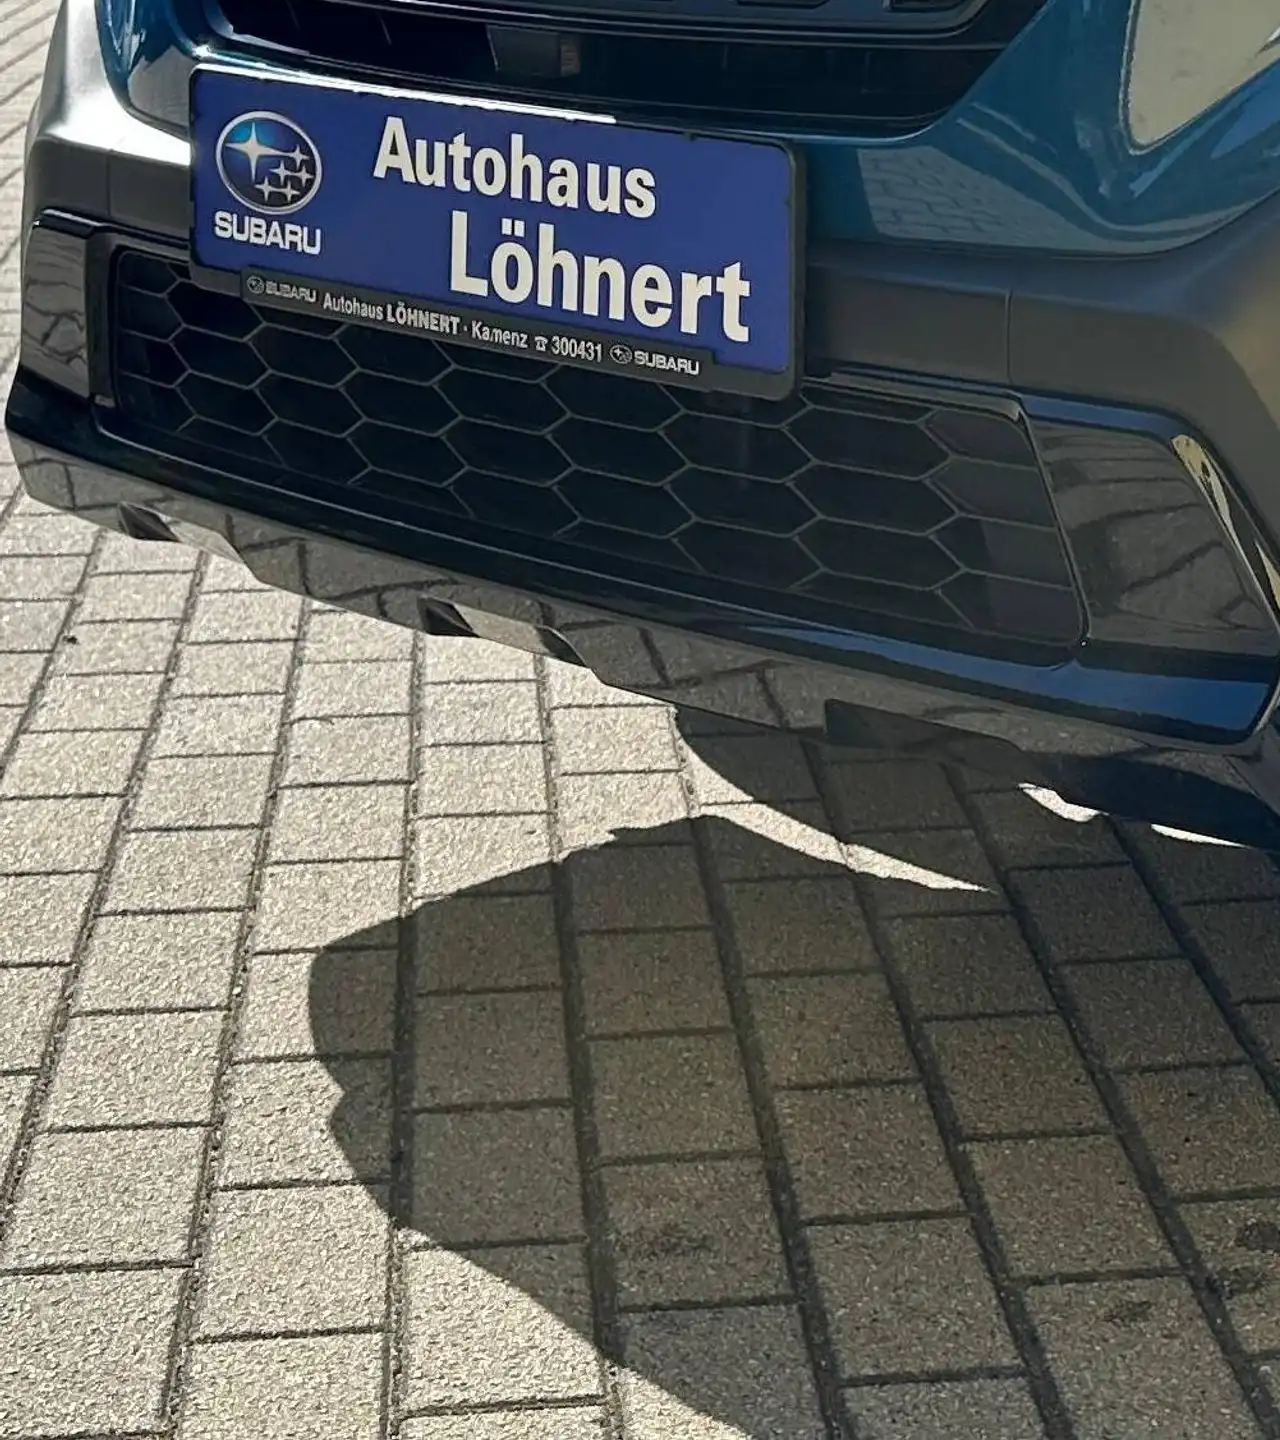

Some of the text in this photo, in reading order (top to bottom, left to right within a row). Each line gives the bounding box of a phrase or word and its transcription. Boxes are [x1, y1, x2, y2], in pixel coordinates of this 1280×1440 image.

[372, 116, 657, 218] Autohaus
[215, 210, 321, 255] SUBARU
[265, 281, 316, 302] SUBARU
[450, 210, 751, 343] Löhnert
[323, 292, 602, 362] Autohaus LÖHNERT Kamenz 300431
[634, 350, 699, 375] SUBARU
